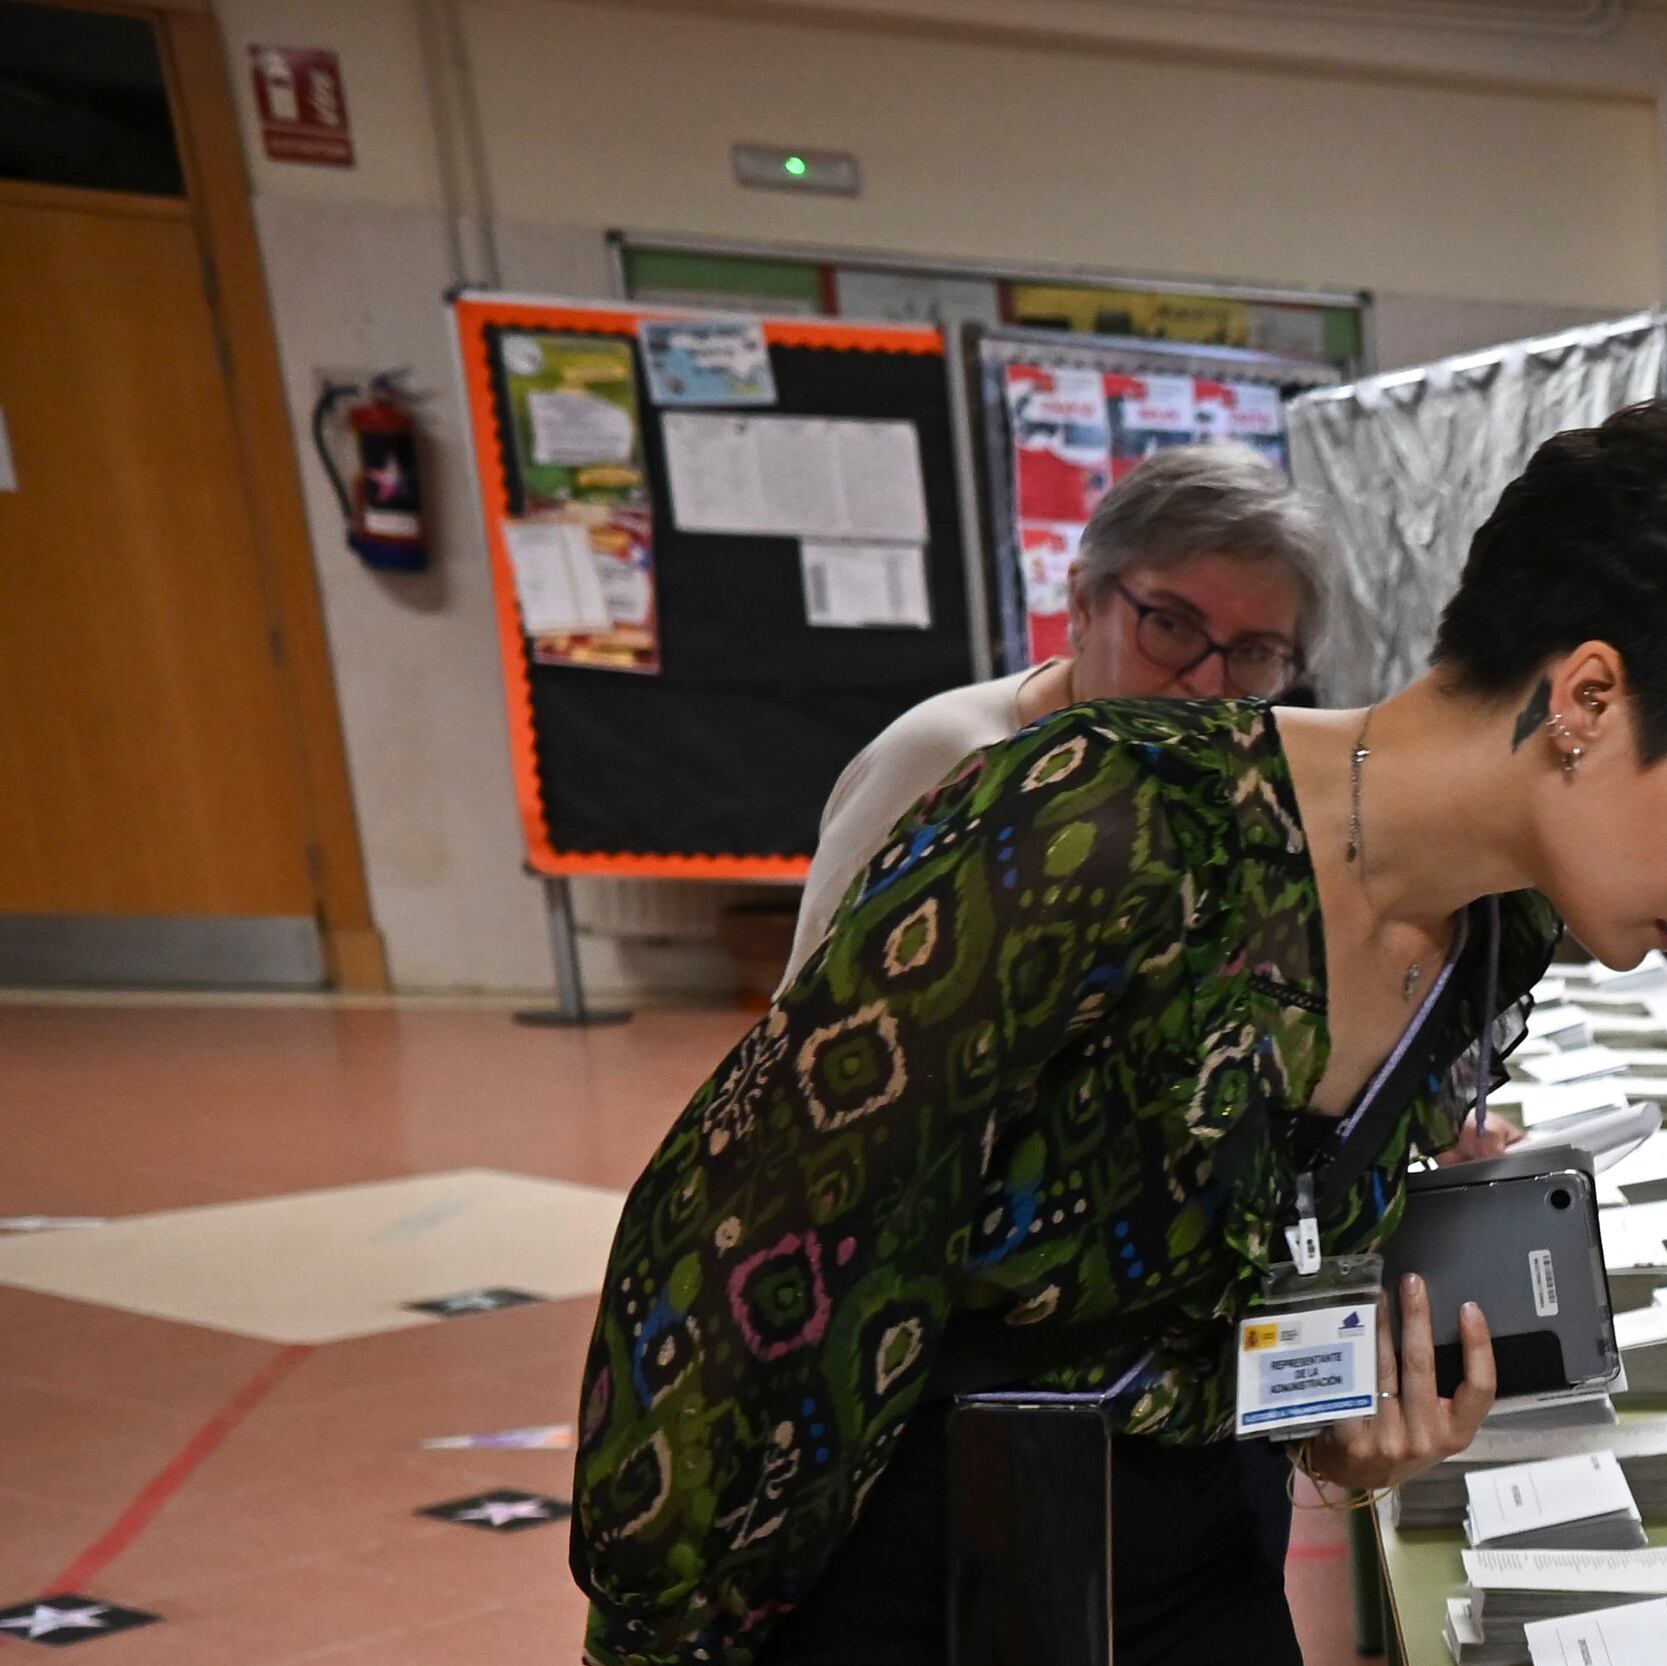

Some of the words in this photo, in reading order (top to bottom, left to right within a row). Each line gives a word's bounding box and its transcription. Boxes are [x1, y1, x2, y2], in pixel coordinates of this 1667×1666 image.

[1270, 1351, 1343, 1370] REPRESENTANTE
[1294, 1369, 1306, 1379] DE
[1307, 1368, 1319, 1378] LA
